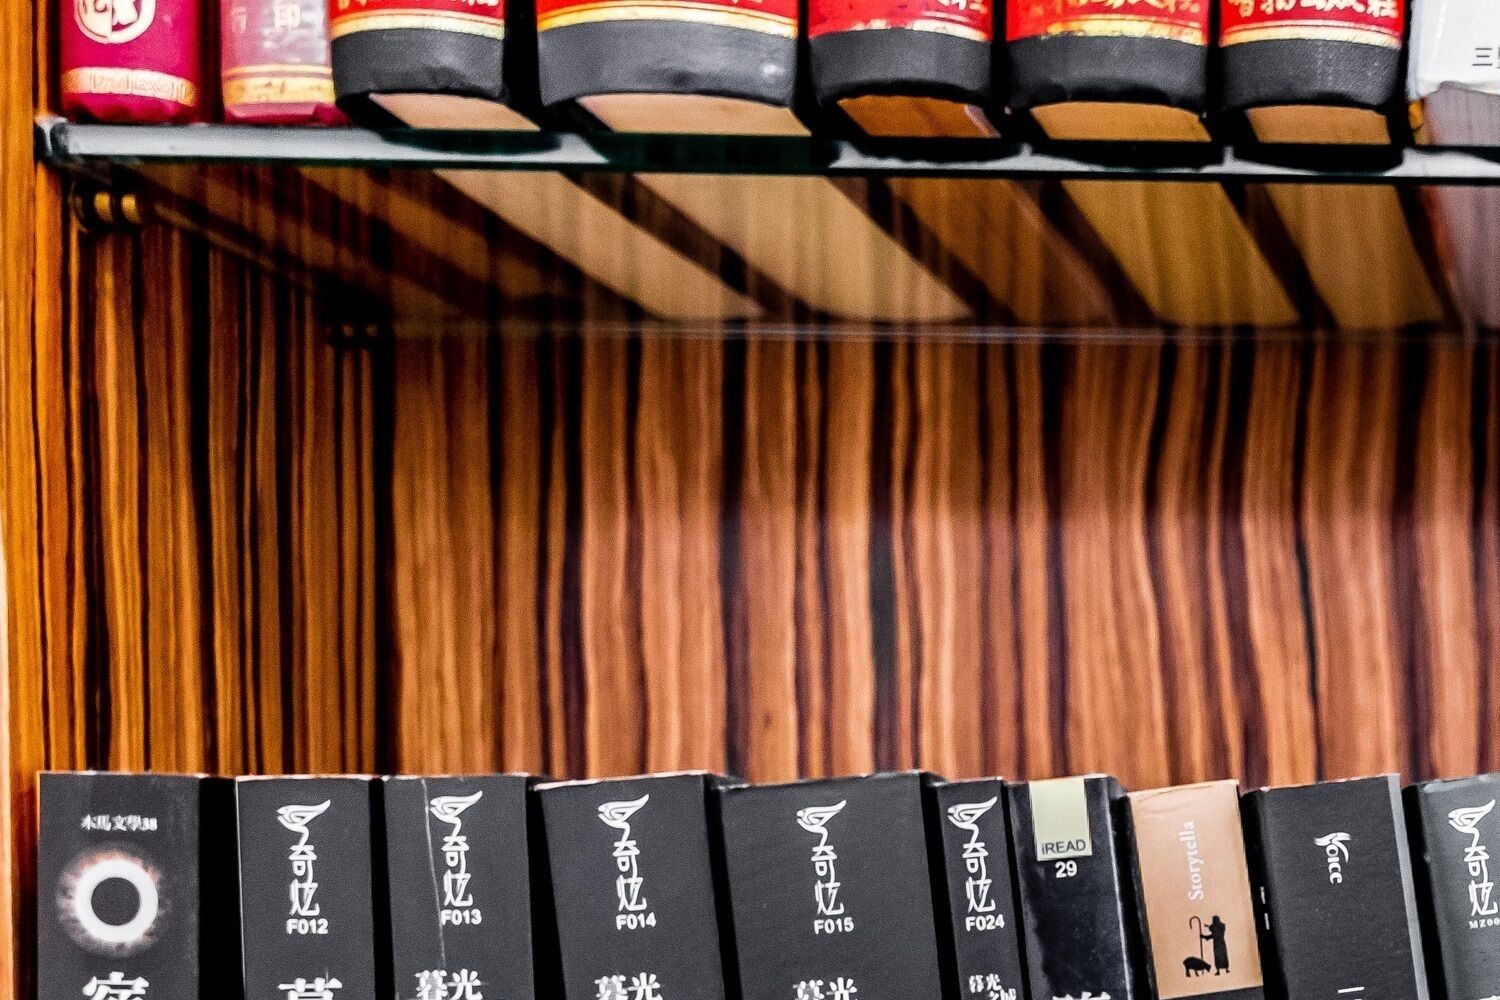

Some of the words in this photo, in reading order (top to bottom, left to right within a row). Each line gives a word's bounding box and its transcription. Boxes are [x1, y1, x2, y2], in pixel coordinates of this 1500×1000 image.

[1041, 839, 1086, 855] iREAD
[1055, 860, 1077, 878] 29
[286, 918, 328, 935] F012
[439, 909, 482, 926] F013
[615, 912, 657, 931] F014
[813, 916, 854, 934] F015
[965, 913, 1005, 932] F024
